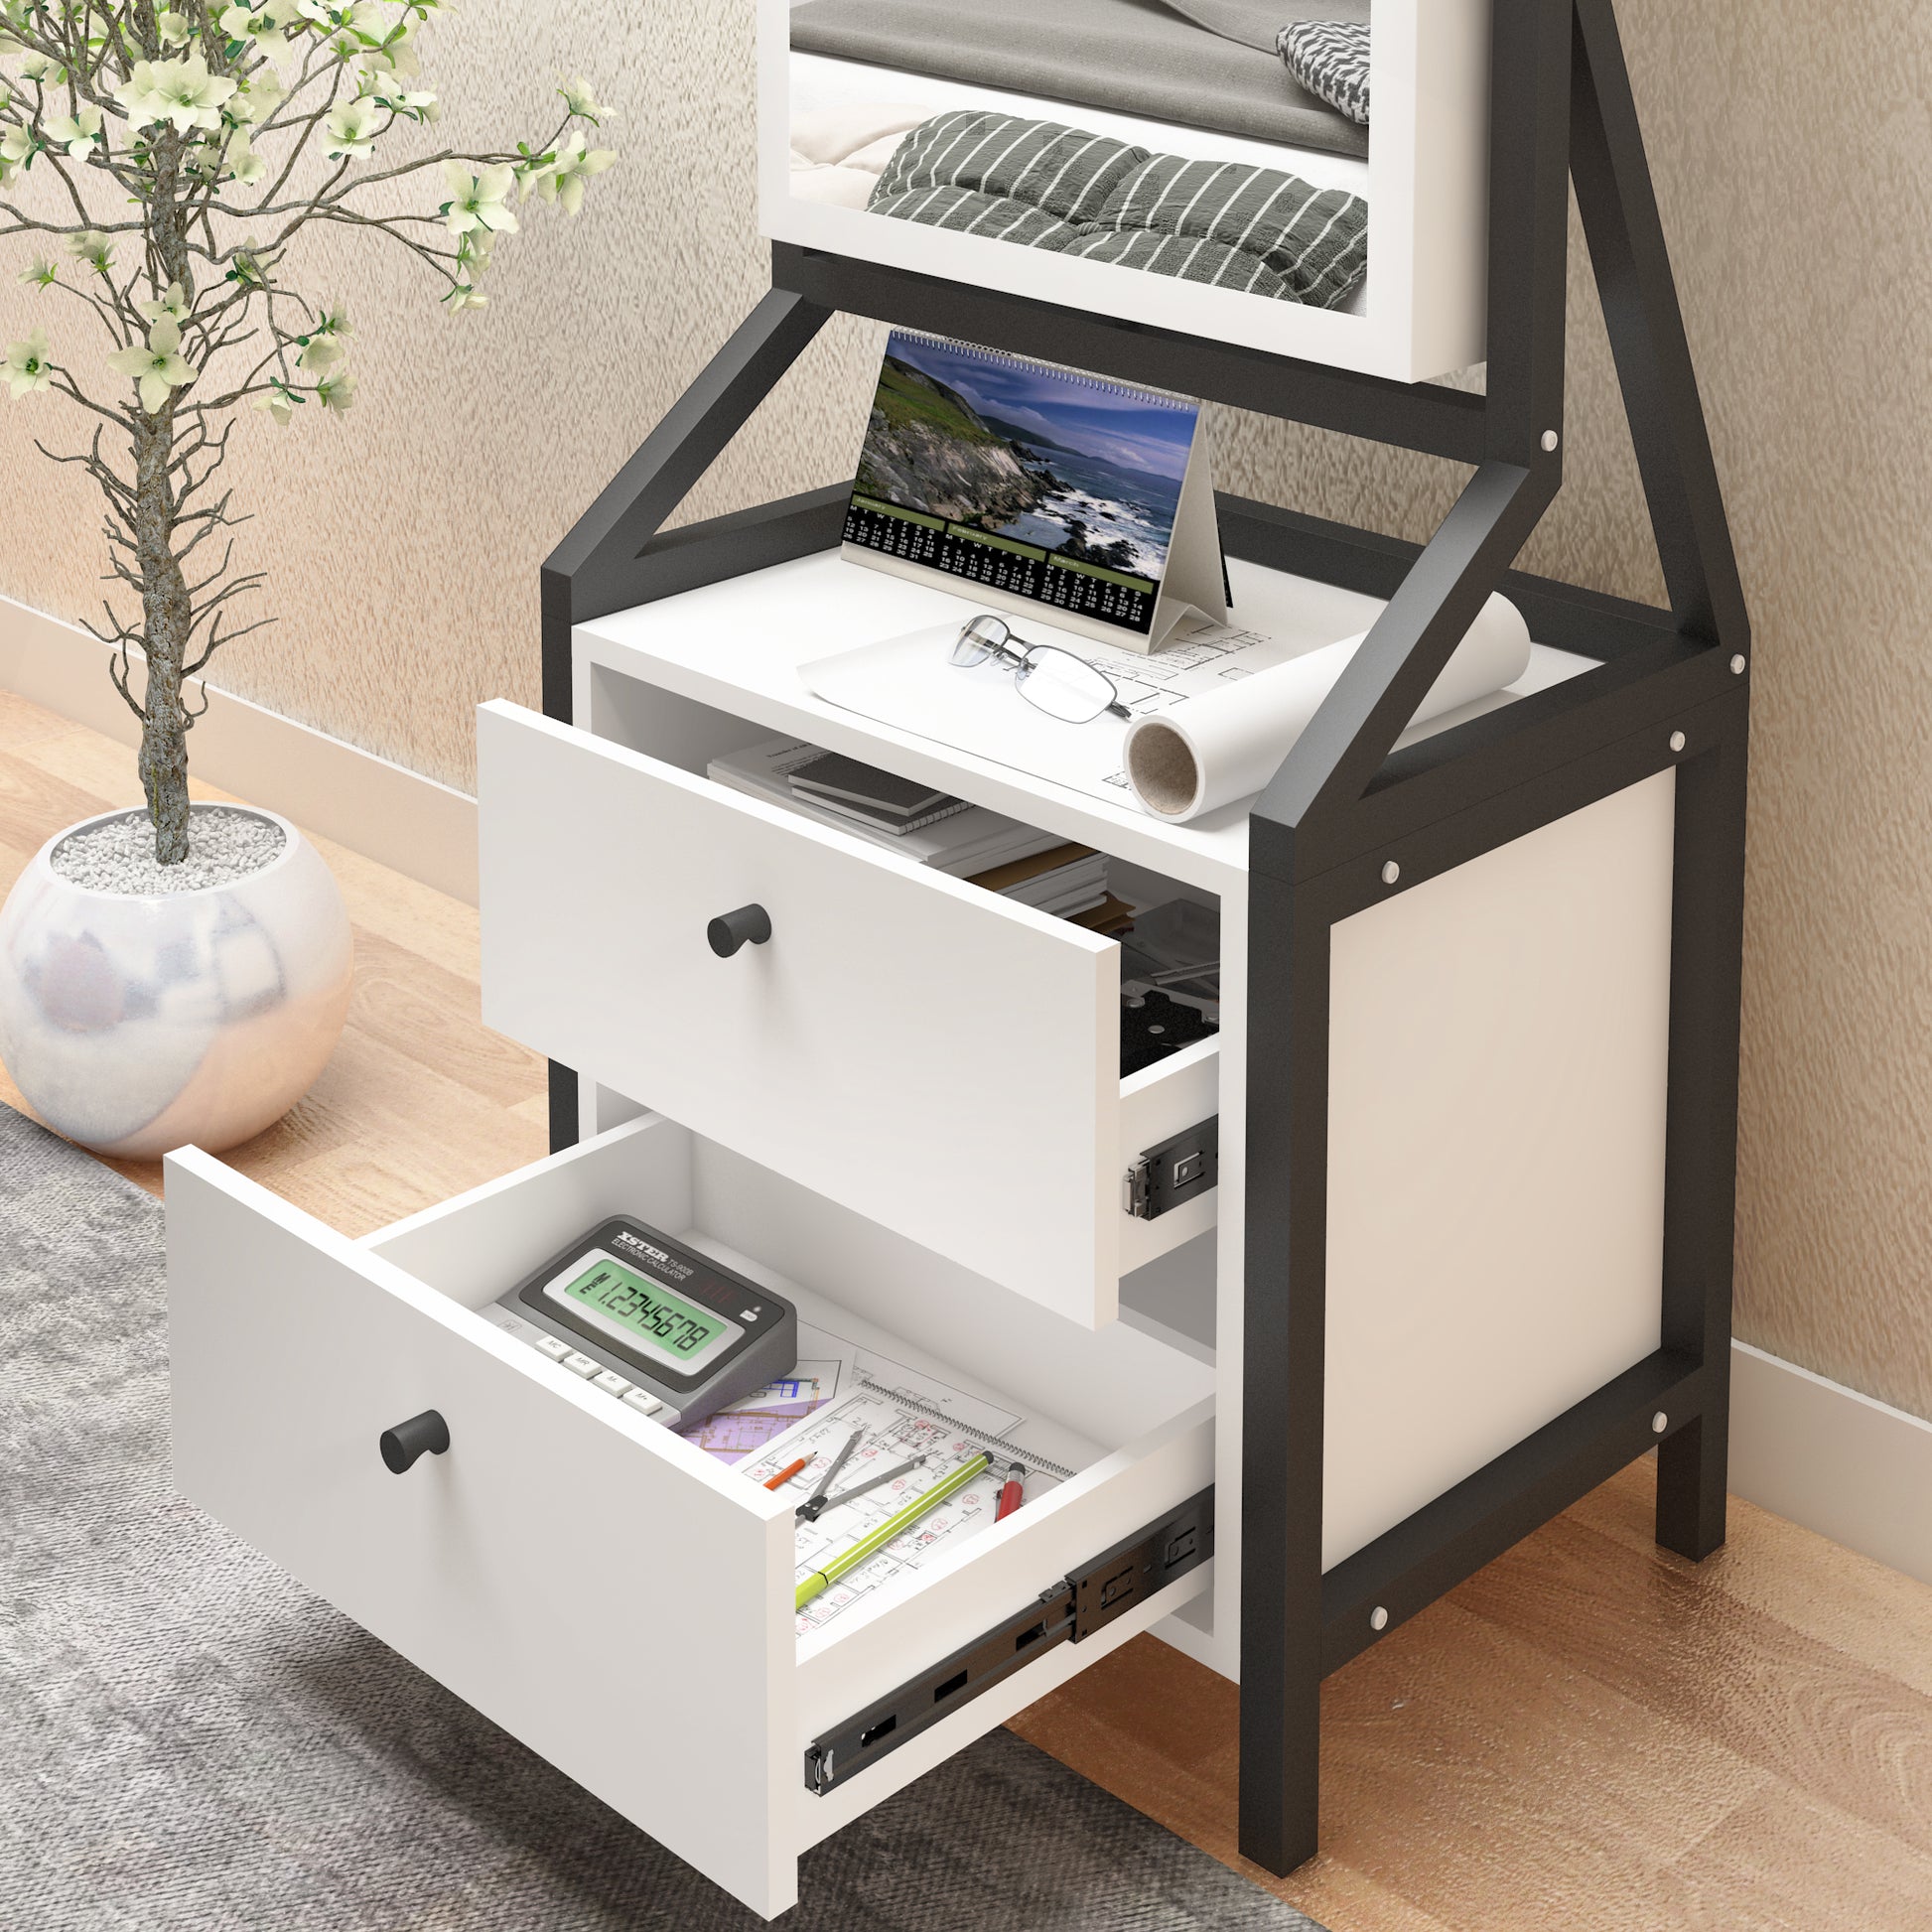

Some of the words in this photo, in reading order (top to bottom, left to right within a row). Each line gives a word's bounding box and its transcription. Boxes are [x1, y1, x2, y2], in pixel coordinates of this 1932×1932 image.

[856, 498, 885, 510] January
[953, 526, 987, 540] February
[1054, 557, 1079, 567] March
[612, 1238, 648, 1261] ELECTRONIC
[647, 1256, 686, 1281] CALCULATOR
